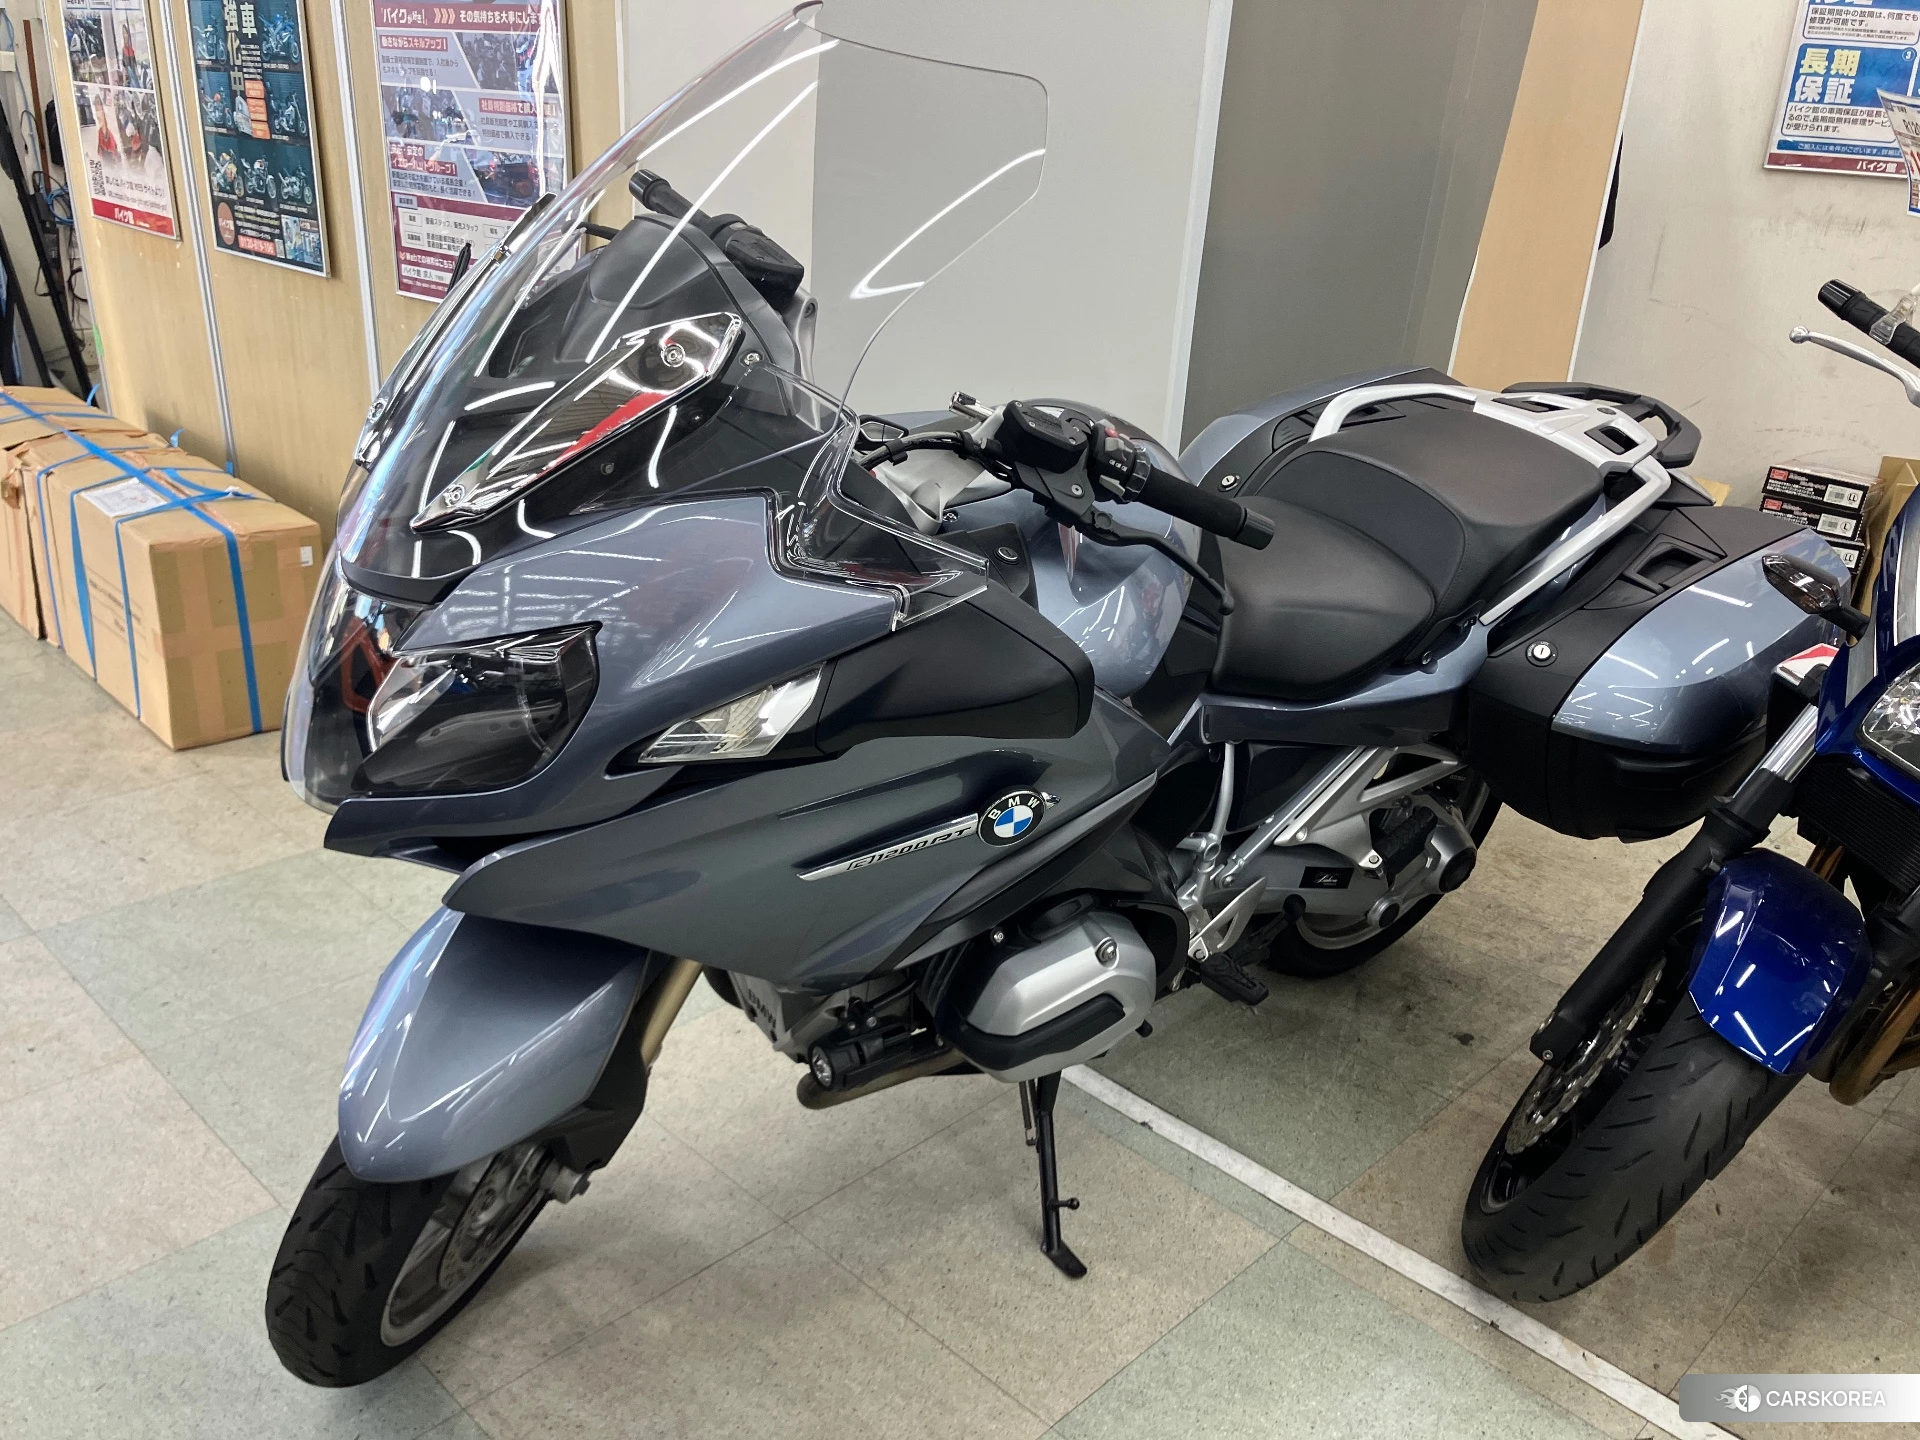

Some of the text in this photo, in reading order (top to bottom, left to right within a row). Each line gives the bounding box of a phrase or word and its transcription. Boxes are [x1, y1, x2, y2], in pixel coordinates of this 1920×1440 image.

[240, 2, 257, 38] 車
[1809, 17, 1869, 28] 修理が可能です。
[1810, 7, 1919, 21] 保証期間中の故障は、何度でも
[1800, 48, 1861, 77] 長期
[1794, 76, 1855, 104] 保証
[1785, 122, 1841, 133] が受けられます。
[1857, 160, 1897, 173] バイク館
[988, 796, 1040, 820] BMW
